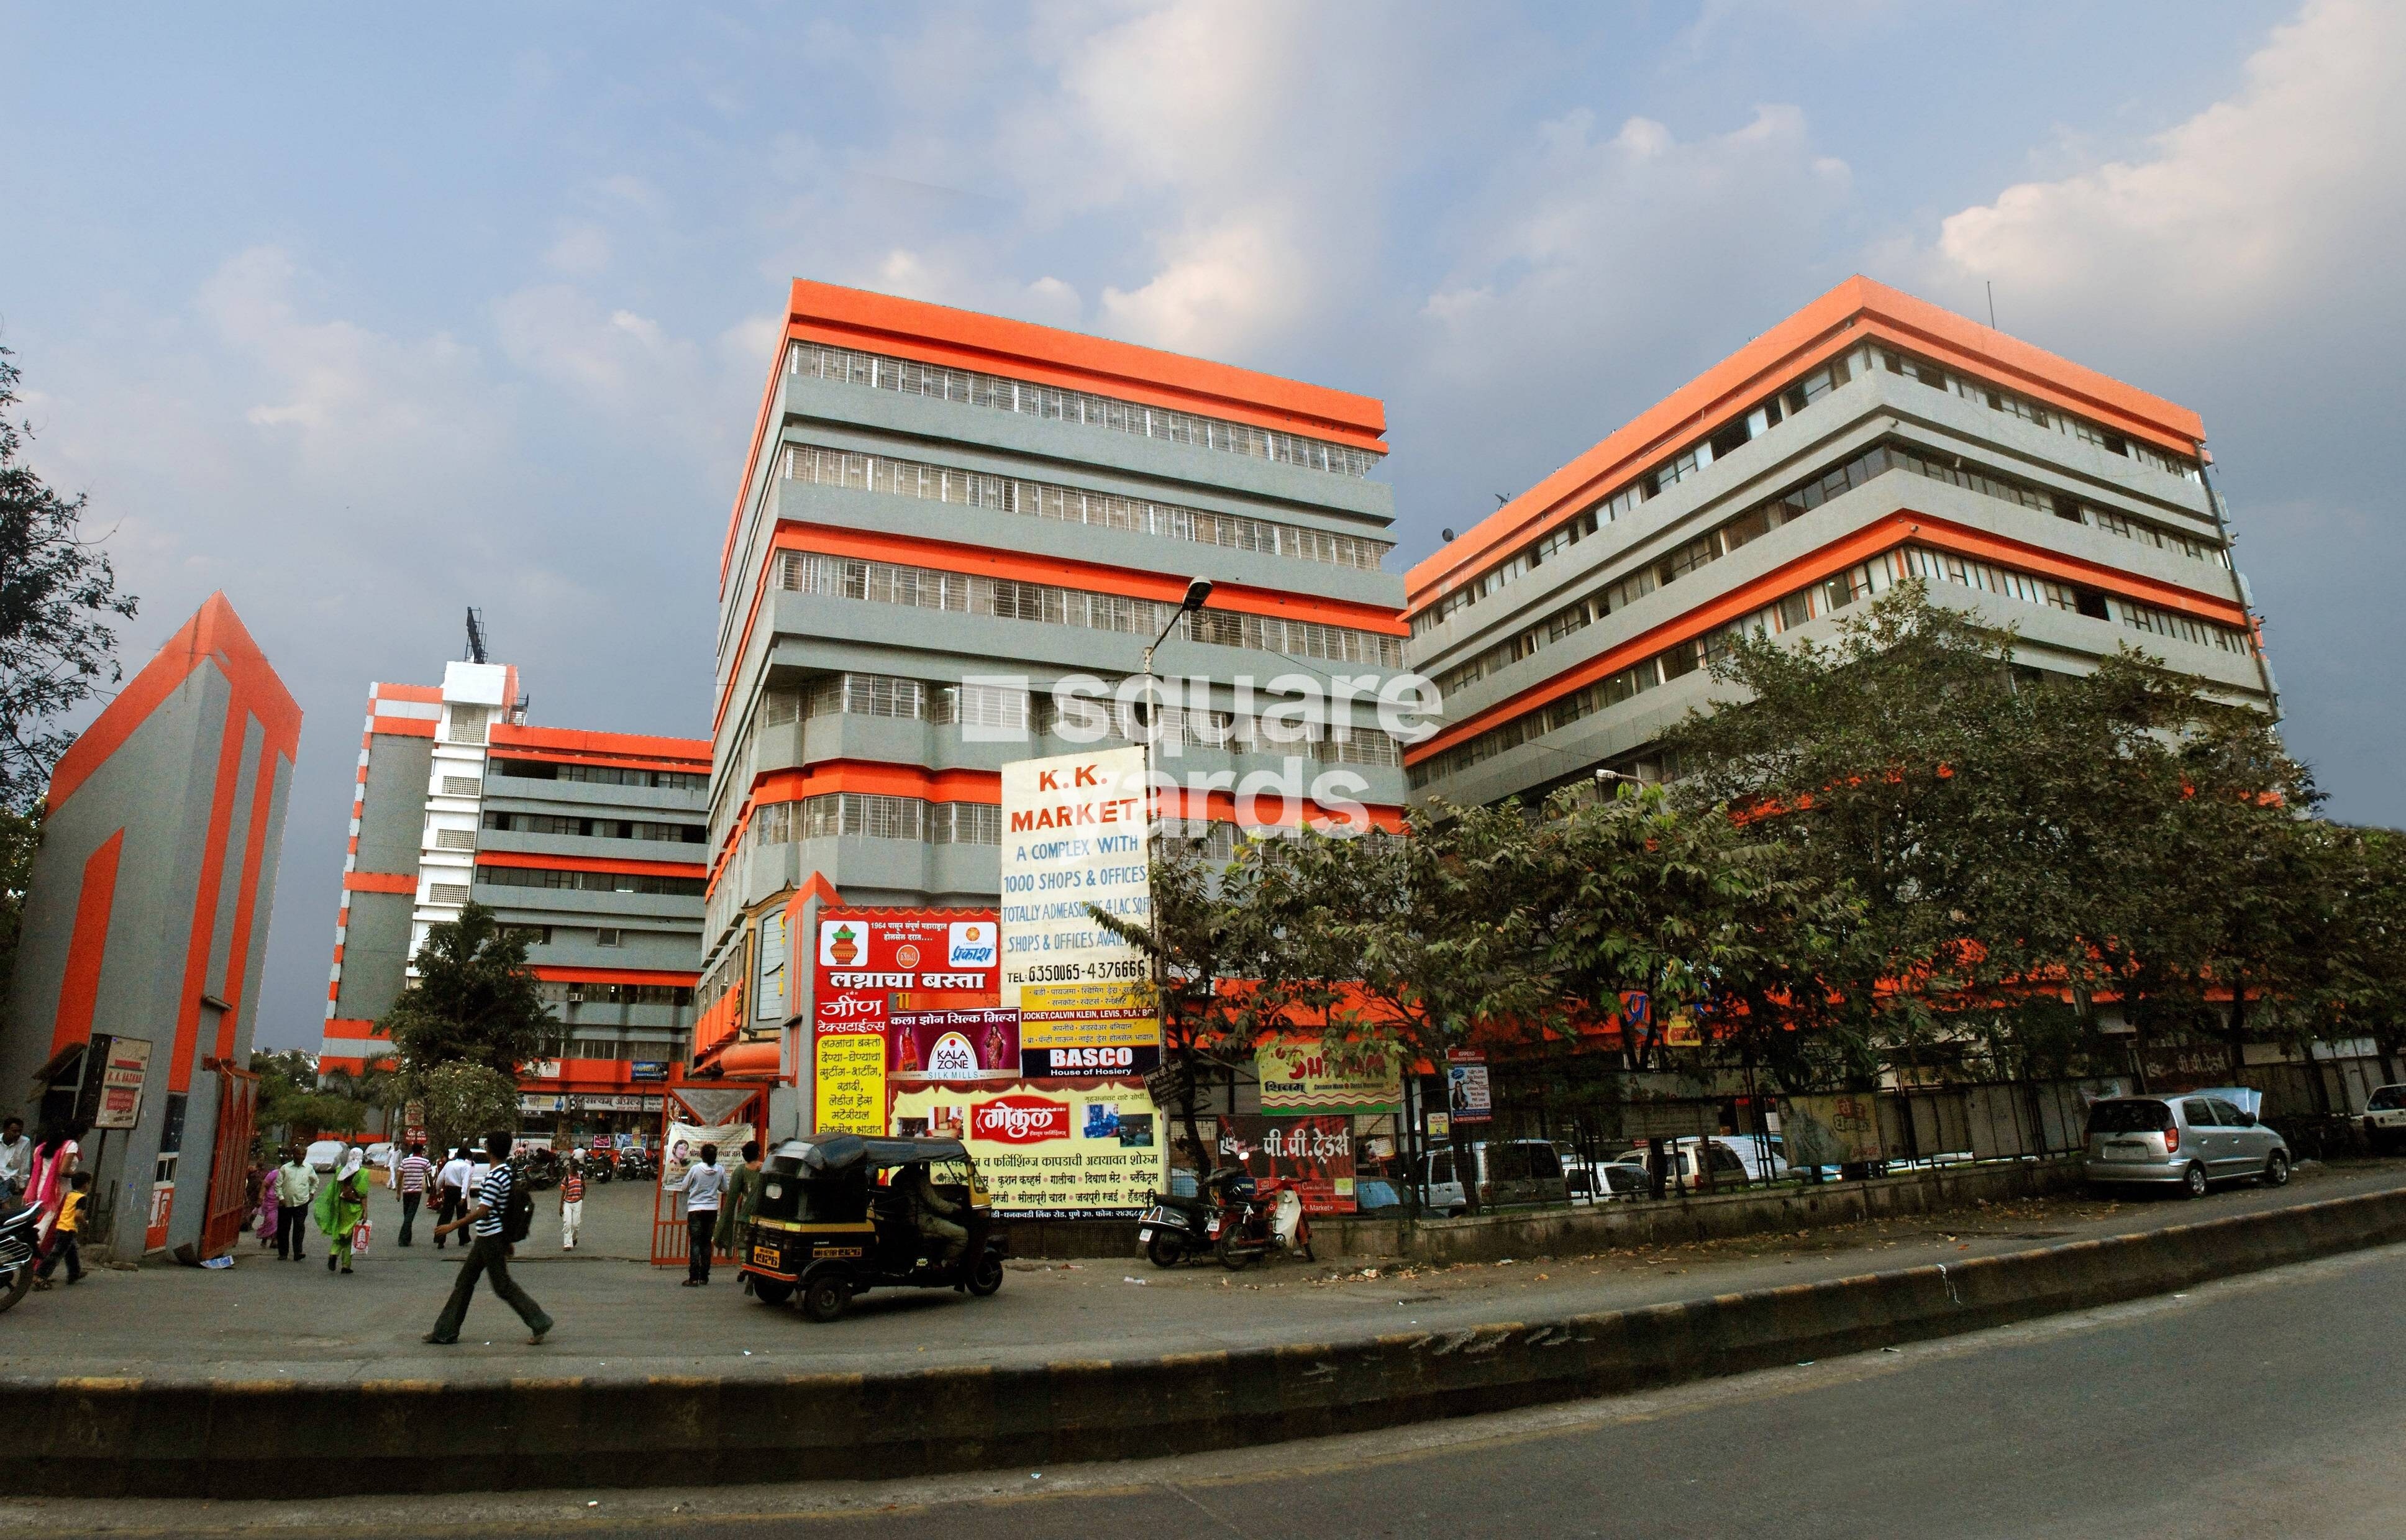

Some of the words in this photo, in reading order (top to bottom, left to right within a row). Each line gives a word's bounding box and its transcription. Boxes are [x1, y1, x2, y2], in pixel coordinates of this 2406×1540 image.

[1011, 798, 1138, 833] MARKET
[1016, 846, 1027, 862] A
[1031, 839, 1090, 860] COMPLEX
[1097, 835, 1139, 854] WITH
[1004, 874, 1034, 893] 1000
[1039, 870, 1082, 890] SHOPS
[1086, 870, 1096, 886] &
[1100, 865, 1146, 885] OFFICES
[1003, 904, 1041, 923] TOTALLY
[1106, 900, 1113, 914] 4
[1114, 898, 1131, 915] LAC
[888, 922, 904, 932] पासून
[905, 920, 919, 932] संपूर्ण
[921, 922, 947, 932] महाराष्ट्रात
[883, 932, 906, 941] होलसेल
[1008, 934, 1040, 953] SHOPS
[1042, 934, 1050, 950] &
[1054, 932, 1094, 950] OFFICES
[951, 945, 994, 963] प्रकाश
[921, 973, 986, 989] बस्ता
[890, 1016, 917, 1026] कला
[919, 1013, 945, 1026] झोन
[947, 1011, 981, 1024] सिल्क
[983, 1011, 1017, 1023] मिल्स
[1076, 1010, 1099, 1019] KLEIN,
[1123, 1009, 1141, 1018] PLA
[818, 1019, 886, 1033] टेक्सटाईल्स
[858, 1038, 881, 1048] बस्ता
[937, 1050, 968, 1060] KALA
[1049, 1047, 1134, 1068] BASCO
[937, 1060, 969, 1070] ZONE
[1050, 1068, 1081, 1077] House
[1083, 1068, 1093, 1076] of
[1095, 1067, 1132, 1077] Hosiery
[927, 1071, 950, 1080] SILK
[951, 1070, 979, 1079] MILLS
[829, 1094, 854, 1106] लेडीज
[857, 1093, 873, 1108] ड्रेस
[980, 1101, 1066, 1138] गोकुळ
[983, 1157, 991, 1167] व
[1041, 1152, 1083, 1167] कापडाची
[997, 1175, 1018, 1188] कुशन
[1019, 1172, 1042, 1186] कव्हर्स
[1050, 1172, 1076, 1185] गालीचा
[1085, 1171, 1107, 1184] दिवाण
[1048, 1192, 1067, 1203] चादर
[1102, 1189, 1119, 1203] रजई
[990, 1210, 1034, 1219] डी-धनकवडी
[1035, 1209, 1052, 1218] लिंक
[1069, 1209, 1080, 1219] पुणे
[755, 1252, 778, 1267] 1926
